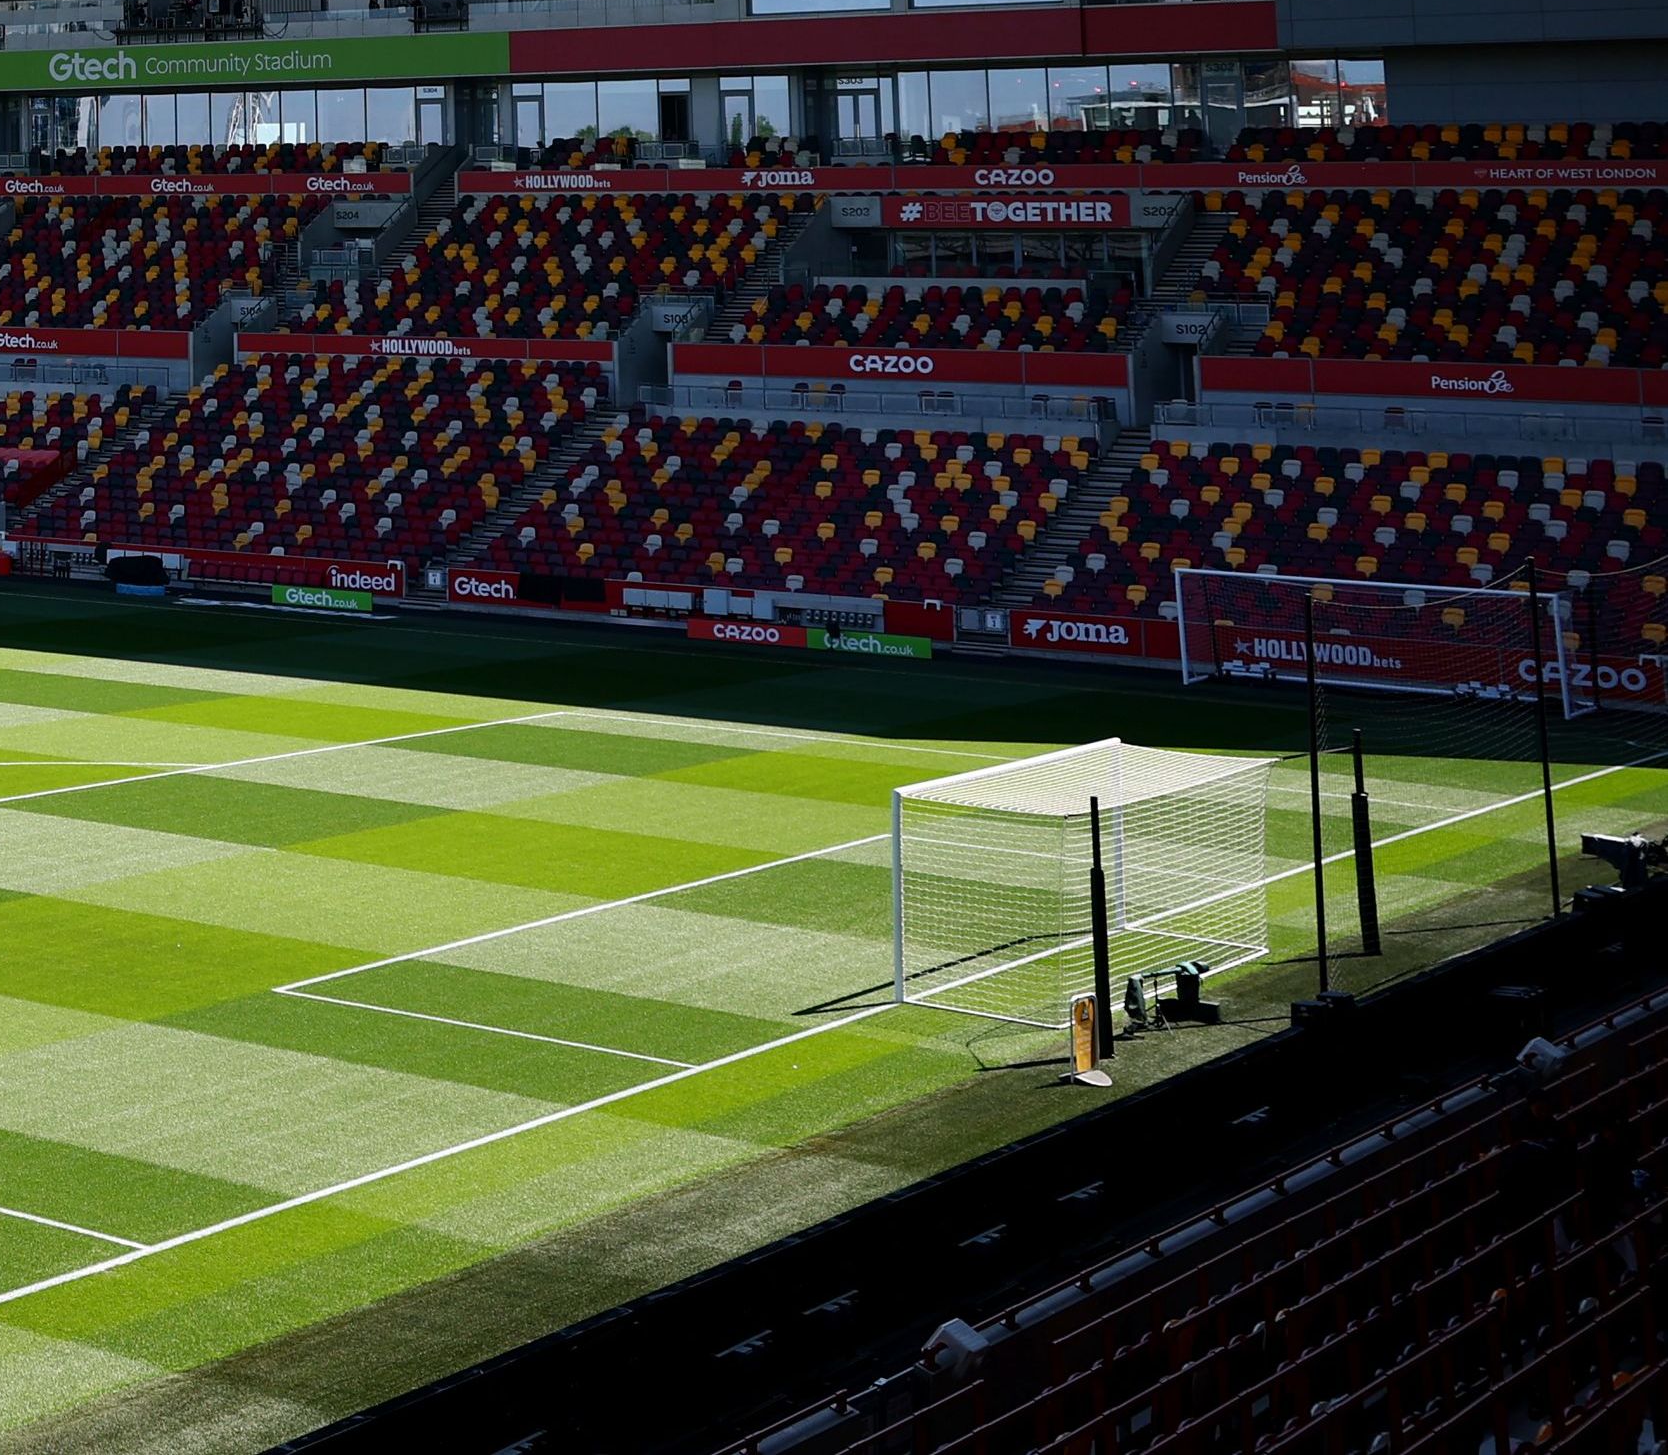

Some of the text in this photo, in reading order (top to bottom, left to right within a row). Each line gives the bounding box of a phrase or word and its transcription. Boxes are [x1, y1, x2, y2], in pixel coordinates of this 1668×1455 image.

[49, 49, 332, 82] Gtech Community Stadium
[974, 169, 1055, 185] CAZOO
[1490, 167, 1657, 179] HEART OF WEST LONDON
[5, 179, 65, 194] Gtech.co.uk
[151, 178, 215, 193] Gtech.co.uk
[306, 177, 375, 192] Gtech.co.uk
[1175, 324, 1207, 335] S102
[849, 355, 934, 374] CAZOO
[326, 565, 396, 592] indeed
[285, 588, 359, 610] Gtech.co.uk
[713, 623, 780, 642] CAZOO
[1518, 658, 1647, 692] CAZOO
